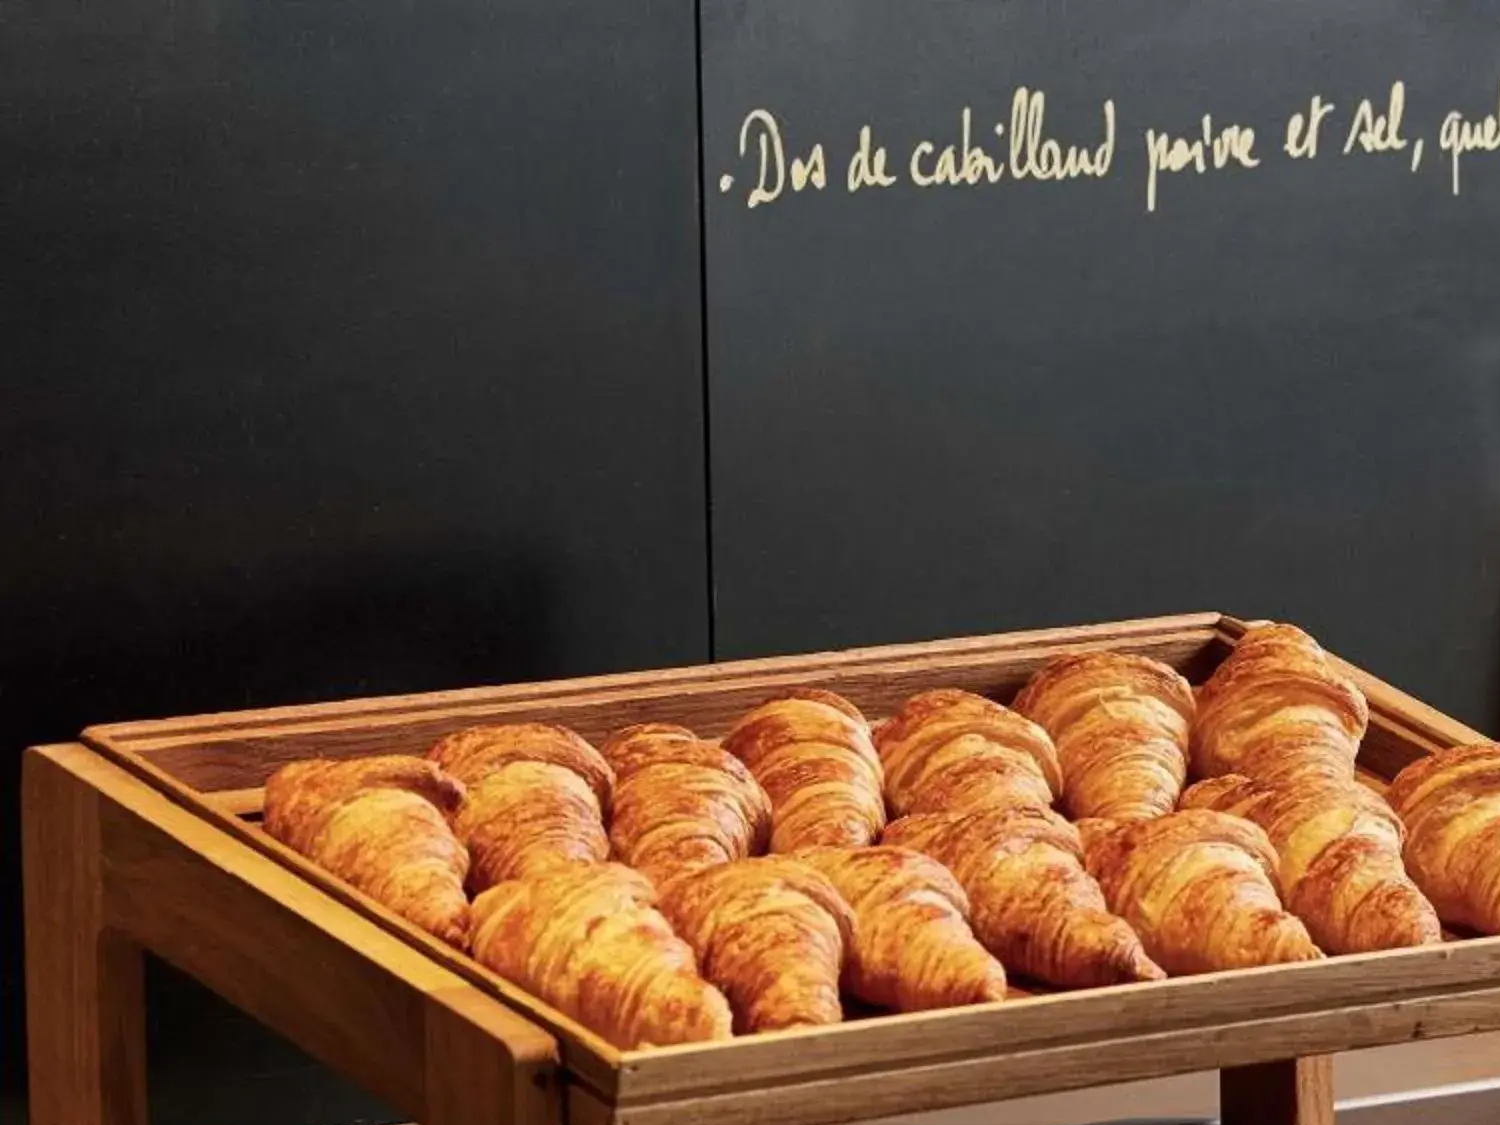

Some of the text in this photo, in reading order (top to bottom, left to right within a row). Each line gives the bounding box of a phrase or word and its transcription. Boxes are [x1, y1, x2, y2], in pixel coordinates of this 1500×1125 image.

[847, 125, 897, 192] de
[910, 86, 1115, 186] cabillaud
[1146, 114, 1261, 212] poivre
[1283, 95, 1337, 159] et
